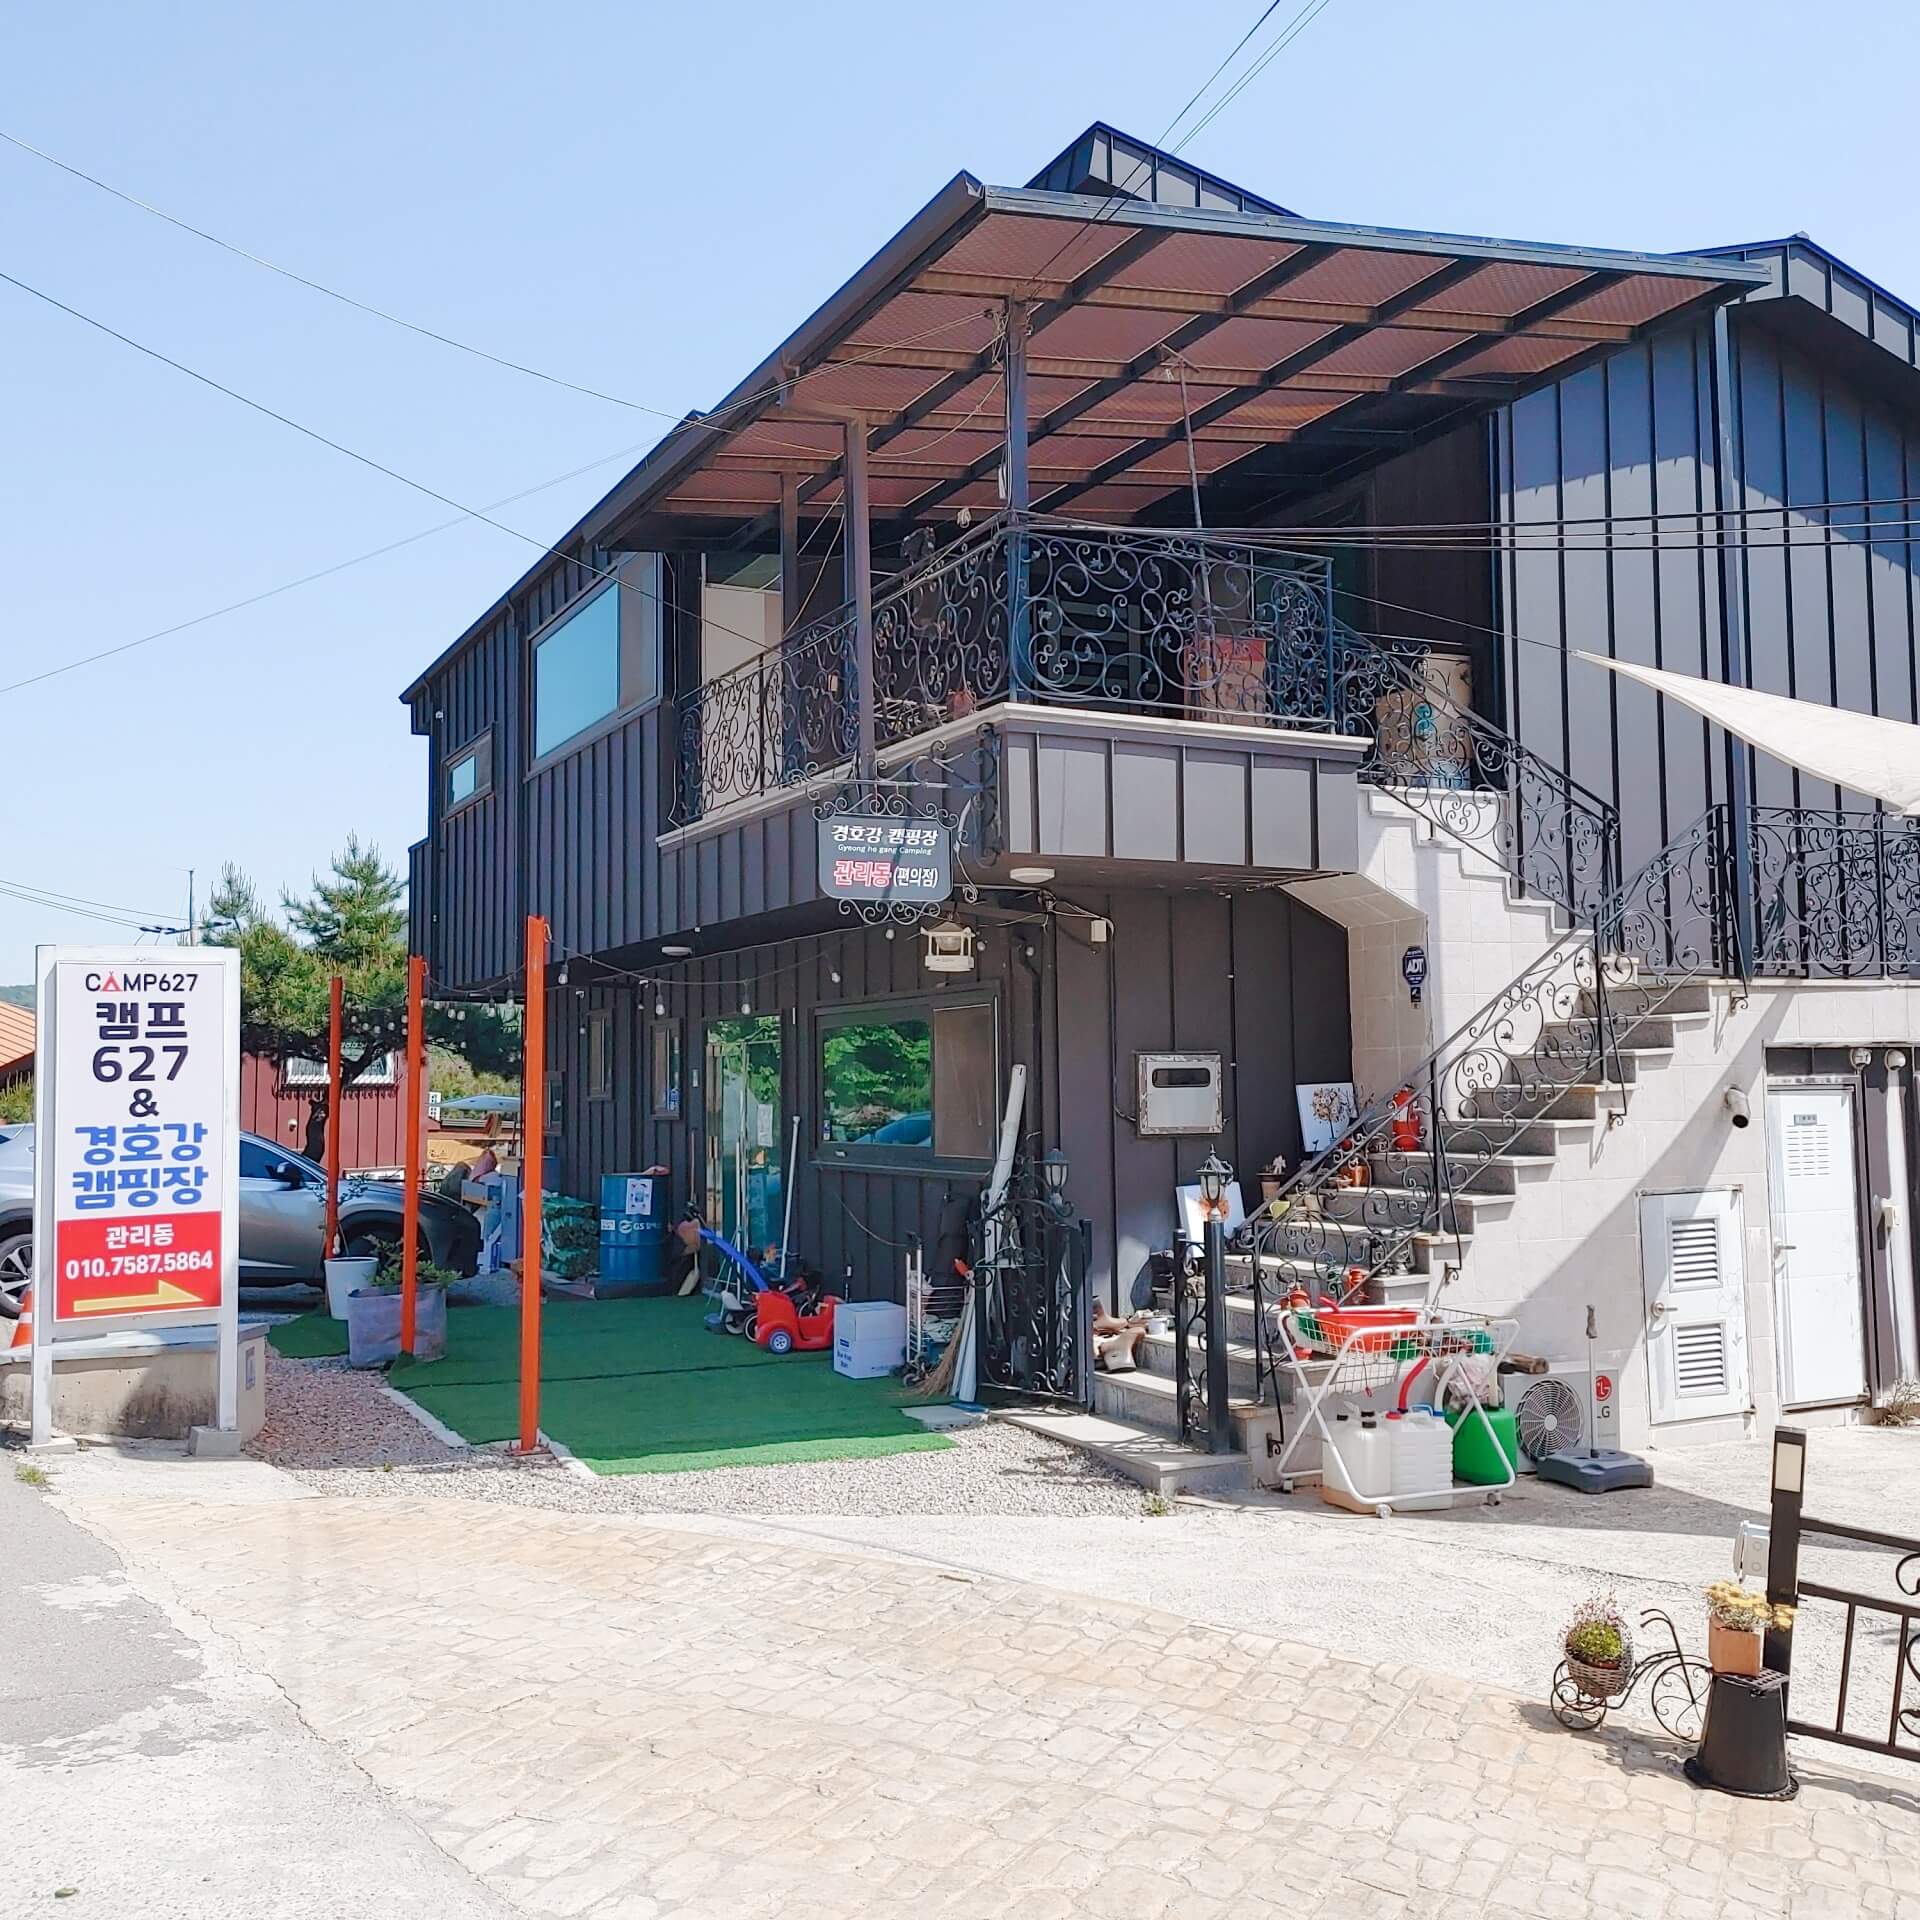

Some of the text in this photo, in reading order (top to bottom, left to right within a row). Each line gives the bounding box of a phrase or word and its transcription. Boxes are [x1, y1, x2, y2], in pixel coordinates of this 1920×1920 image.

[832, 825, 939, 846] 경호강 캠핑장
[838, 844, 866, 853] Gyeong
[899, 846, 932, 856] Camping
[833, 860, 939, 888] 관리동 (편의점)
[1406, 958, 1424, 974] ADT
[85, 972, 199, 992] CAMP627
[96, 1002, 188, 1040] 캠프
[92, 1045, 189, 1083] 627
[129, 1088, 160, 1118] &
[75, 1122, 208, 1166] 경호강
[72, 1166, 209, 1210] 캠핑장
[105, 1223, 175, 1250] 관리동
[65, 1250, 214, 1280] 010.7587.5864
